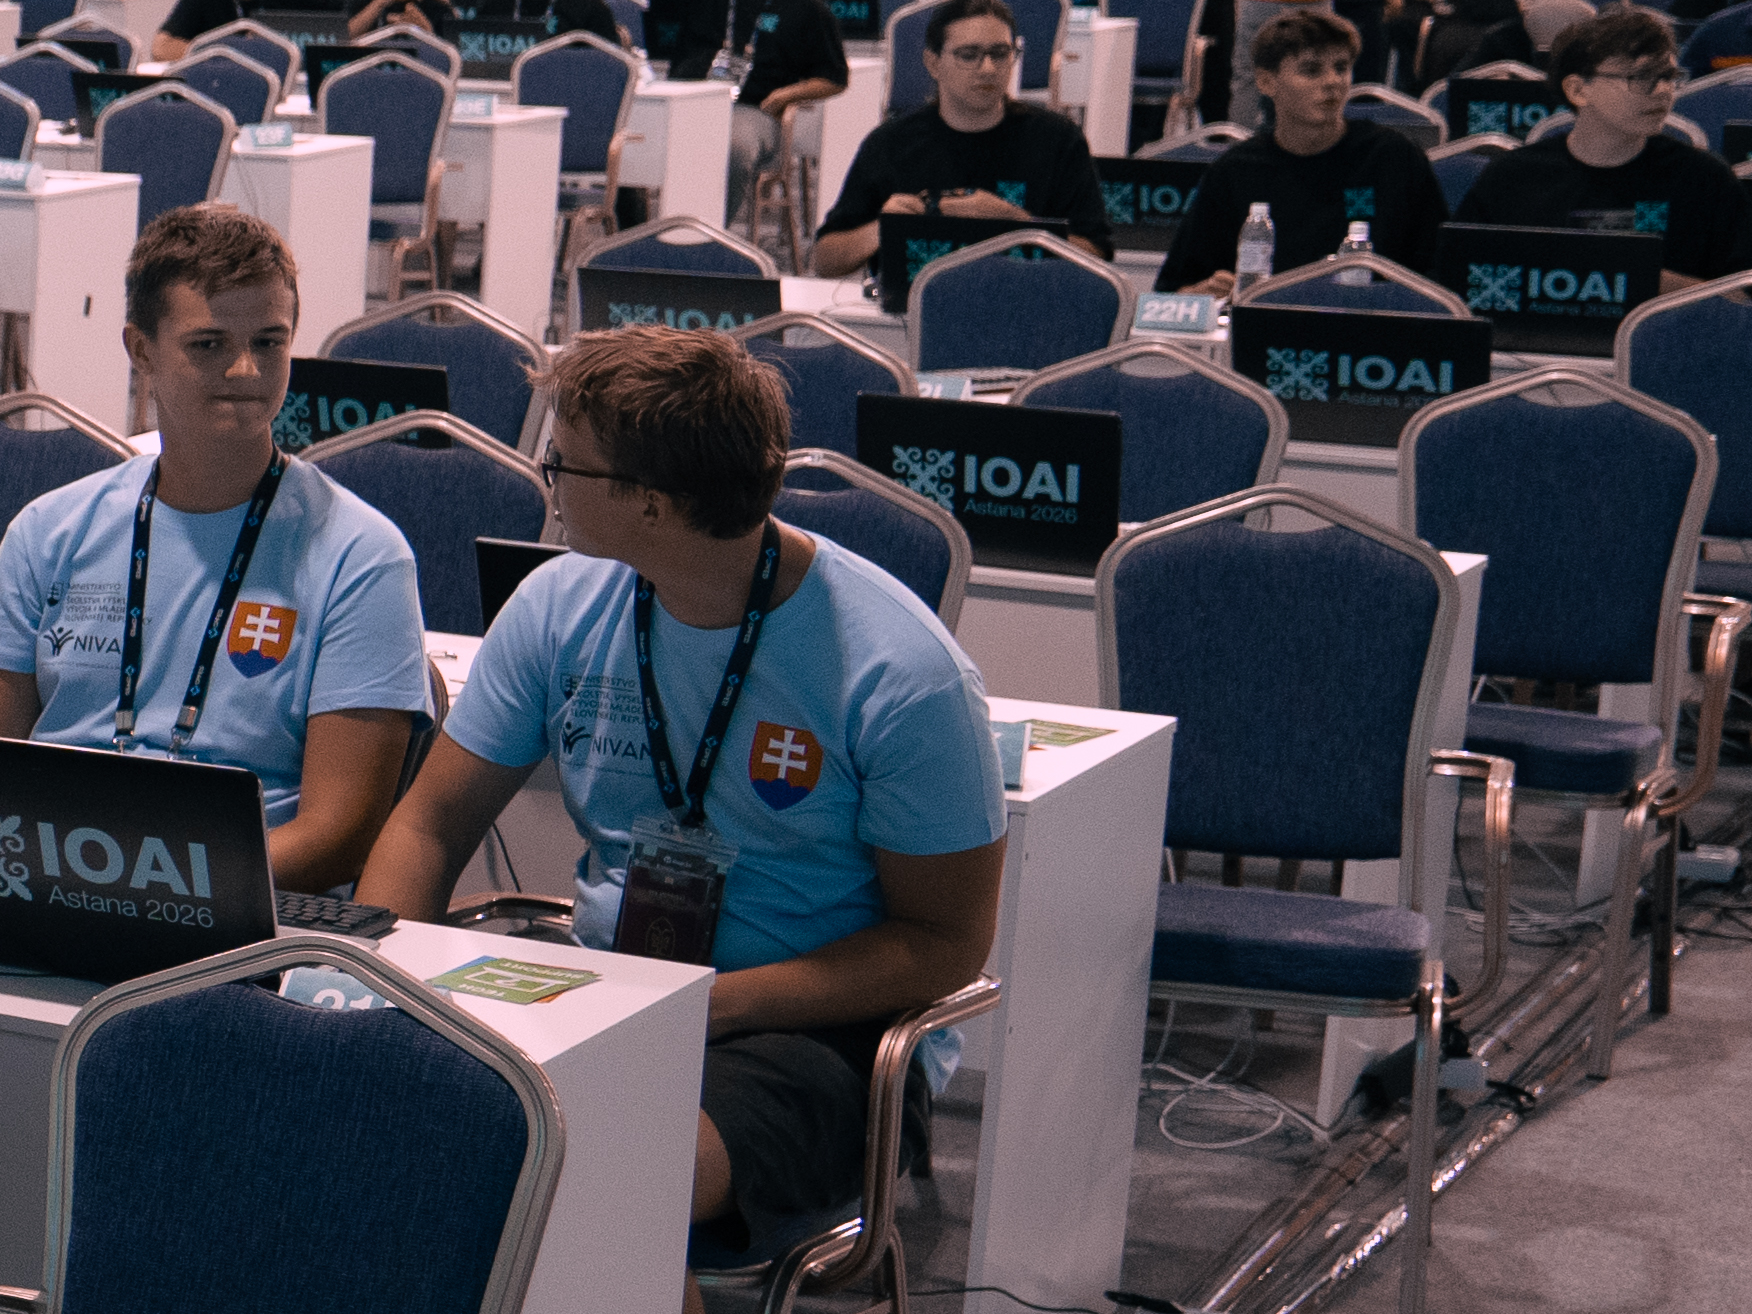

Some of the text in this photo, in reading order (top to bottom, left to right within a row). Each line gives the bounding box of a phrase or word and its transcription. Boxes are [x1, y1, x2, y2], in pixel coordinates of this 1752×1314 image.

[827, 0, 869, 20] OAI
[1528, 267, 1627, 303] IOAI
[1142, 301, 1200, 323] 22H
[1336, 352, 1454, 394] IOAI
[963, 454, 1080, 503] IOAI
[963, 498, 1078, 524] Astana 2026
[74, 636, 121, 654] NIVA
[37, 821, 212, 899] IOAI
[48, 885, 214, 929] Astana 2026
